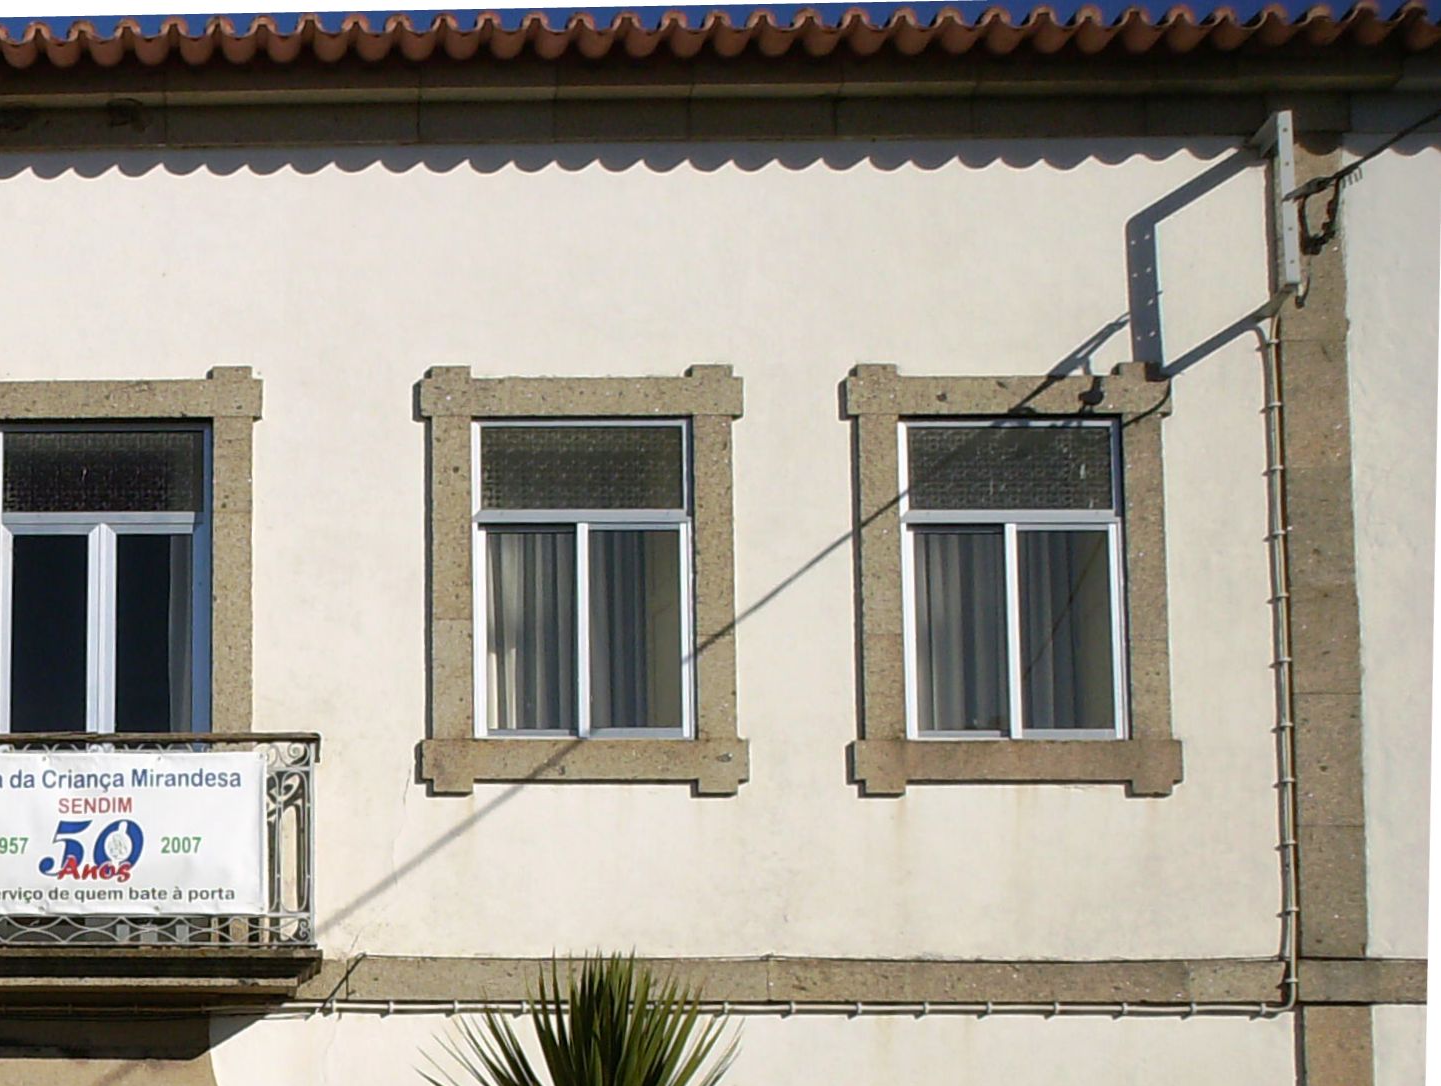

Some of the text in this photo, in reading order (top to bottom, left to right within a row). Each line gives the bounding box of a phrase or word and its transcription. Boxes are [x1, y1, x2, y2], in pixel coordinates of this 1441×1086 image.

[9, 769, 35, 789] da
[42, 769, 125, 793] Criança
[131, 768, 242, 788] Mirandesa
[58, 797, 133, 814] SENDIM
[38, 819, 144, 877] 50
[161, 836, 202, 854] 2007
[57, 855, 131, 883] Anos
[48, 887, 69, 900] de
[74, 889, 124, 903] quem
[129, 887, 168, 900] bate
[172, 886, 183, 900] à
[188, 887, 235, 902] porta
